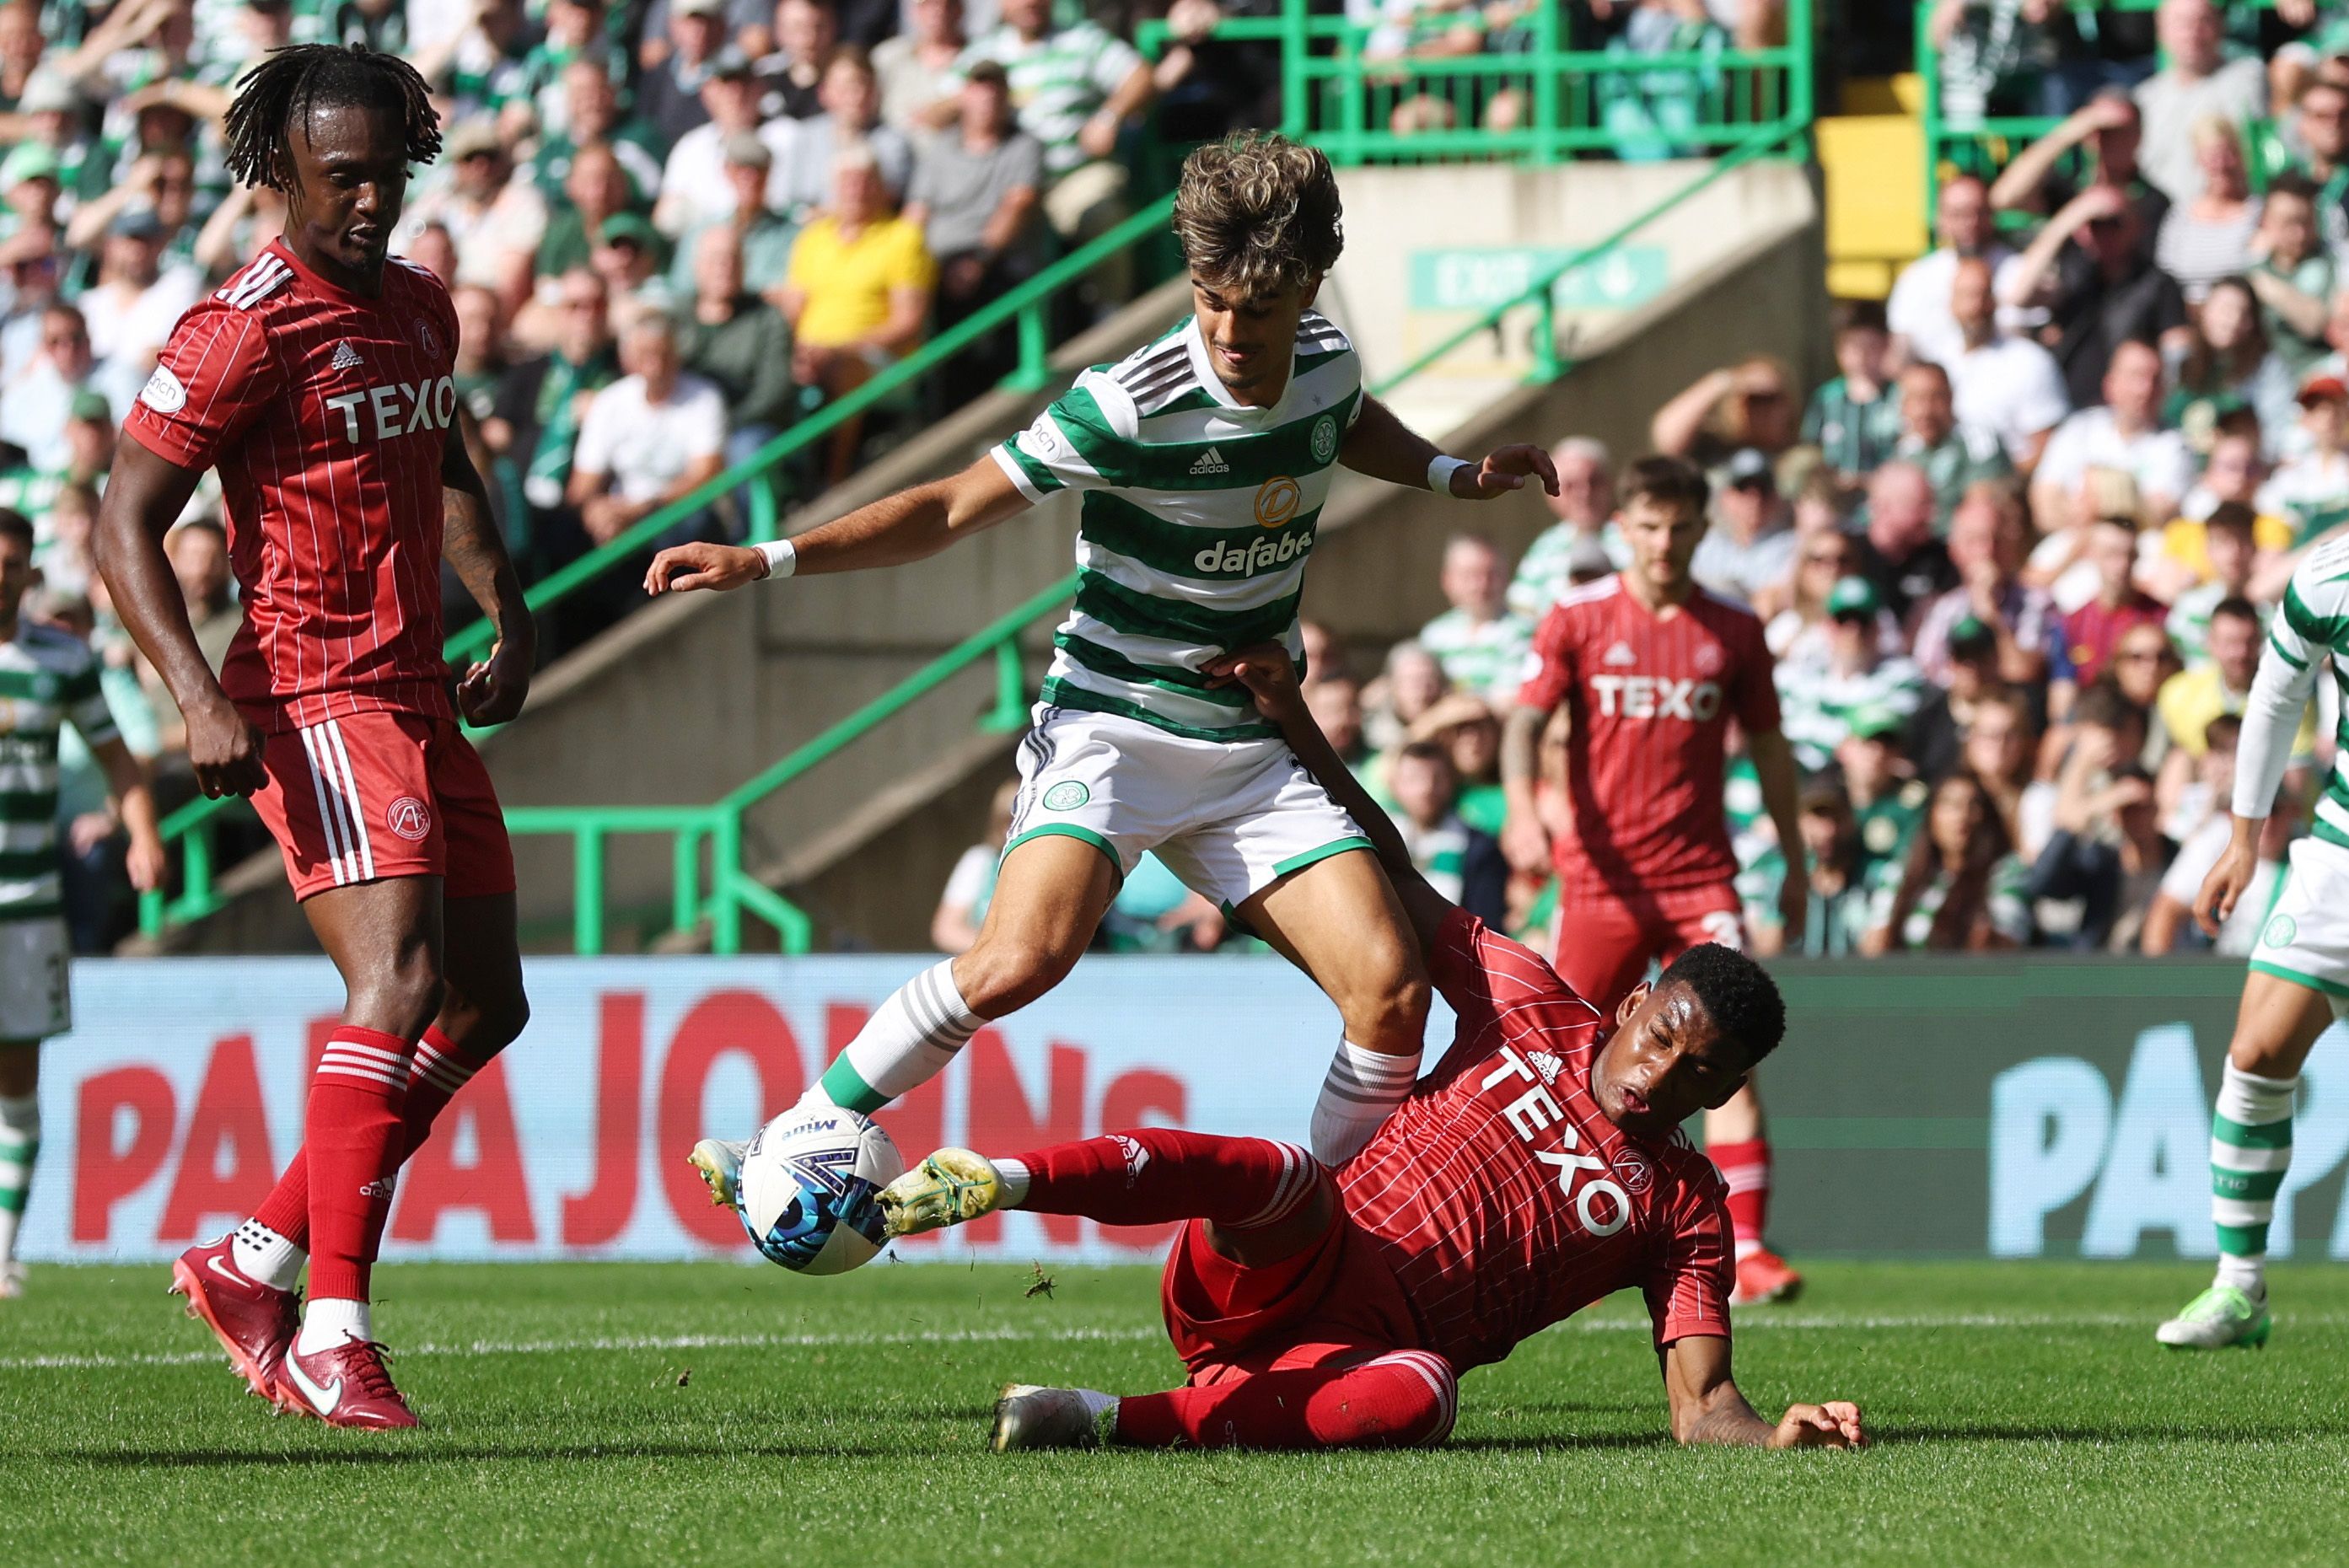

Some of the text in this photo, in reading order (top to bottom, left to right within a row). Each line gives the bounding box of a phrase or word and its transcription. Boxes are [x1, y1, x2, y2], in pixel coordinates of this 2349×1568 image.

[331, 355, 364, 370] adidas
[325, 375, 456, 444] TEXO
[1189, 463, 1230, 475] adidas
[1194, 530, 1313, 577] dafabe
[1590, 674, 1722, 722] TEXO
[1527, 1050, 1556, 1086] adidas
[73, 1015, 536, 1244] PAA
[1481, 1045, 1631, 1237] TEXO
[1988, 1017, 2349, 1260] PAP
